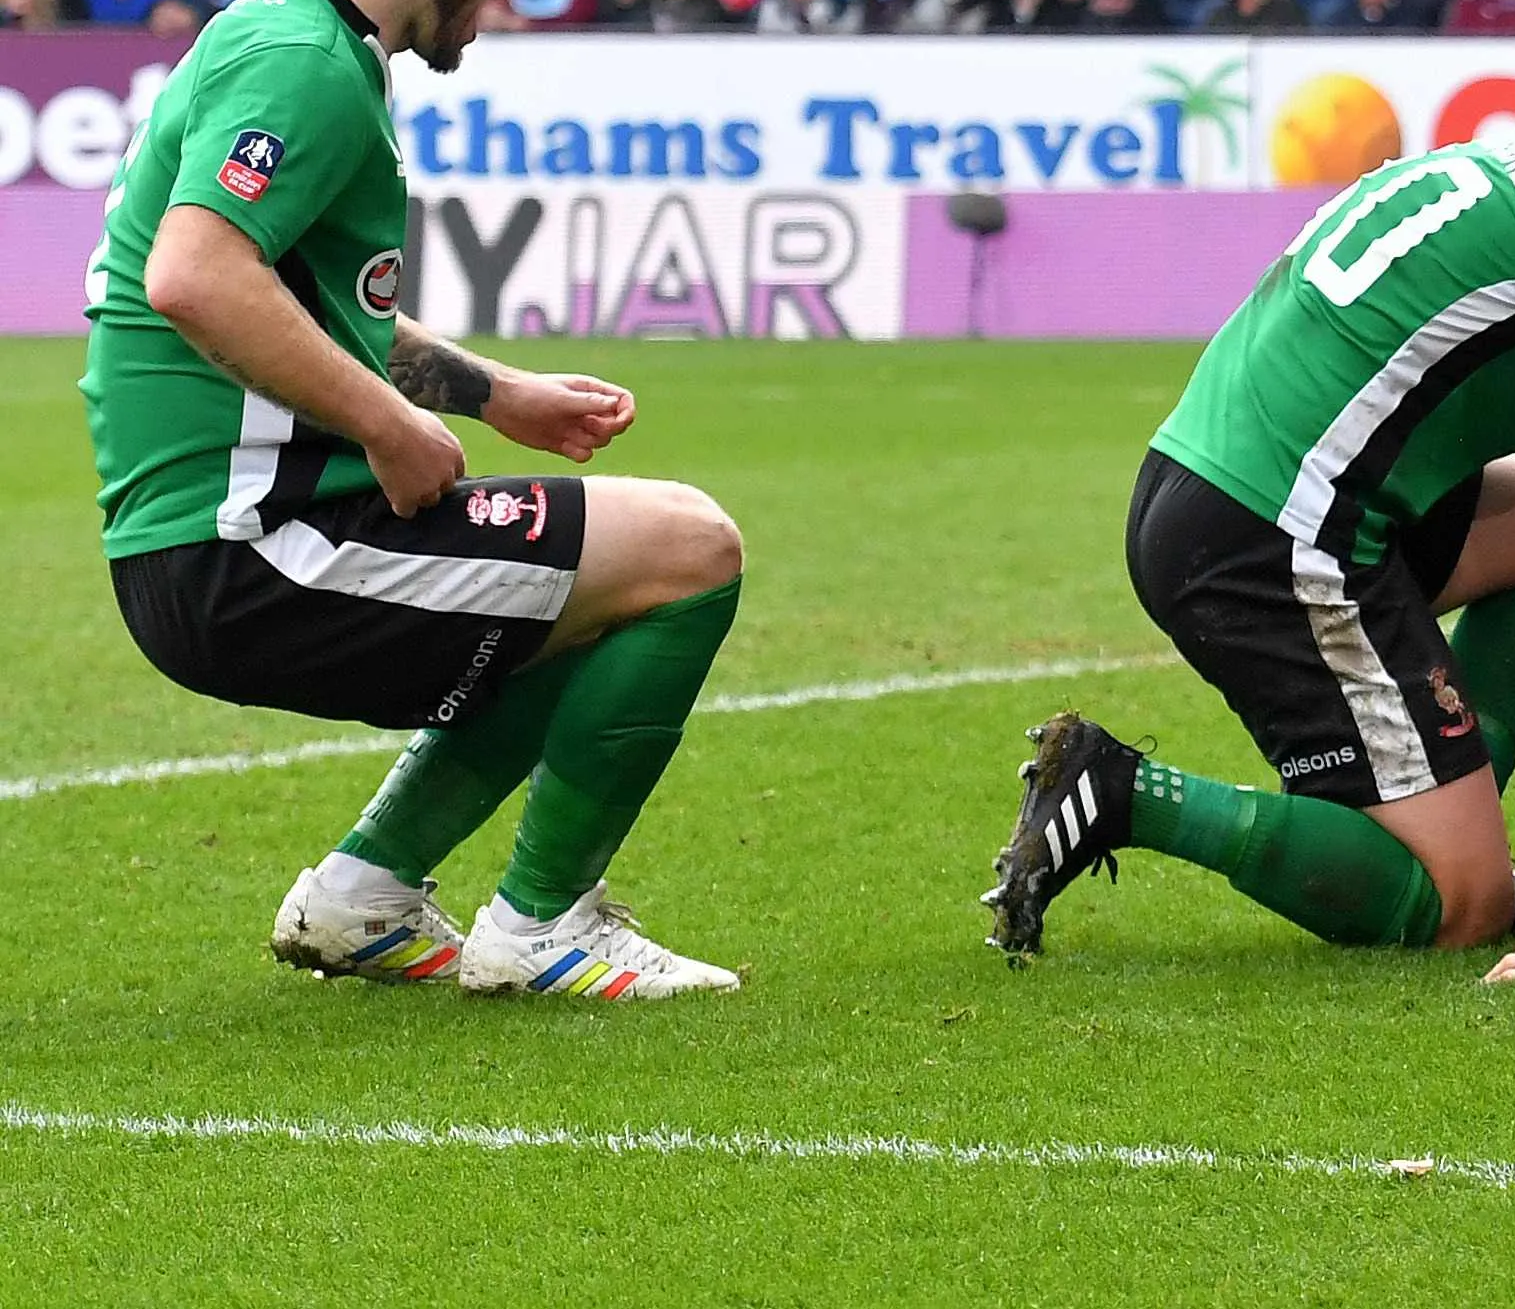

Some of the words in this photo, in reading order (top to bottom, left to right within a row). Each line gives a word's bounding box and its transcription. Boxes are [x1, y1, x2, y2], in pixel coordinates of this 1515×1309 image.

[408, 97, 763, 179] thams
[804, 97, 1184, 182] Travel
[408, 195, 862, 338] YJAR
[1280, 744, 1357, 779] olsons
